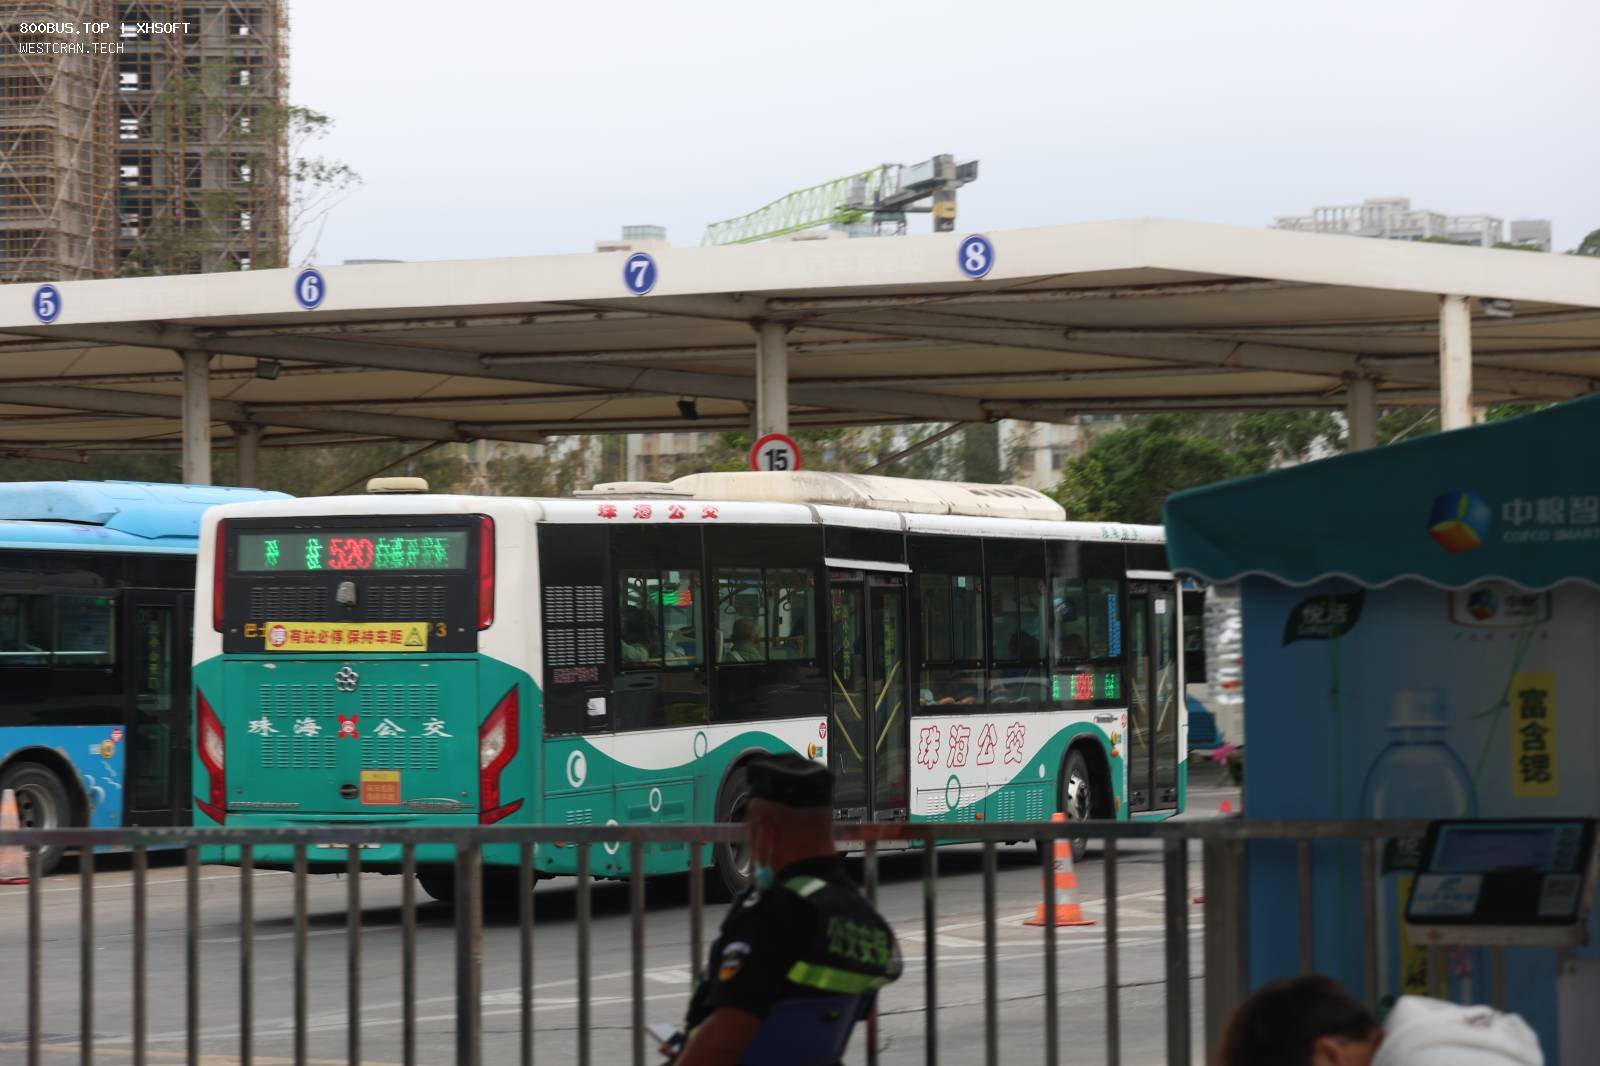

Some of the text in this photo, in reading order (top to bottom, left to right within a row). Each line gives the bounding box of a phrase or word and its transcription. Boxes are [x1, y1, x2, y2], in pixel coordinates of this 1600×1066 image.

[965, 242, 985, 271] 8
[630, 260, 650, 287] 7
[301, 275, 319, 302] 6
[39, 291, 55, 316] 5
[765, 448, 788, 471] 15
[596, 503, 719, 519] 珠海公交
[917, 721, 1026, 770] 珠海公交
